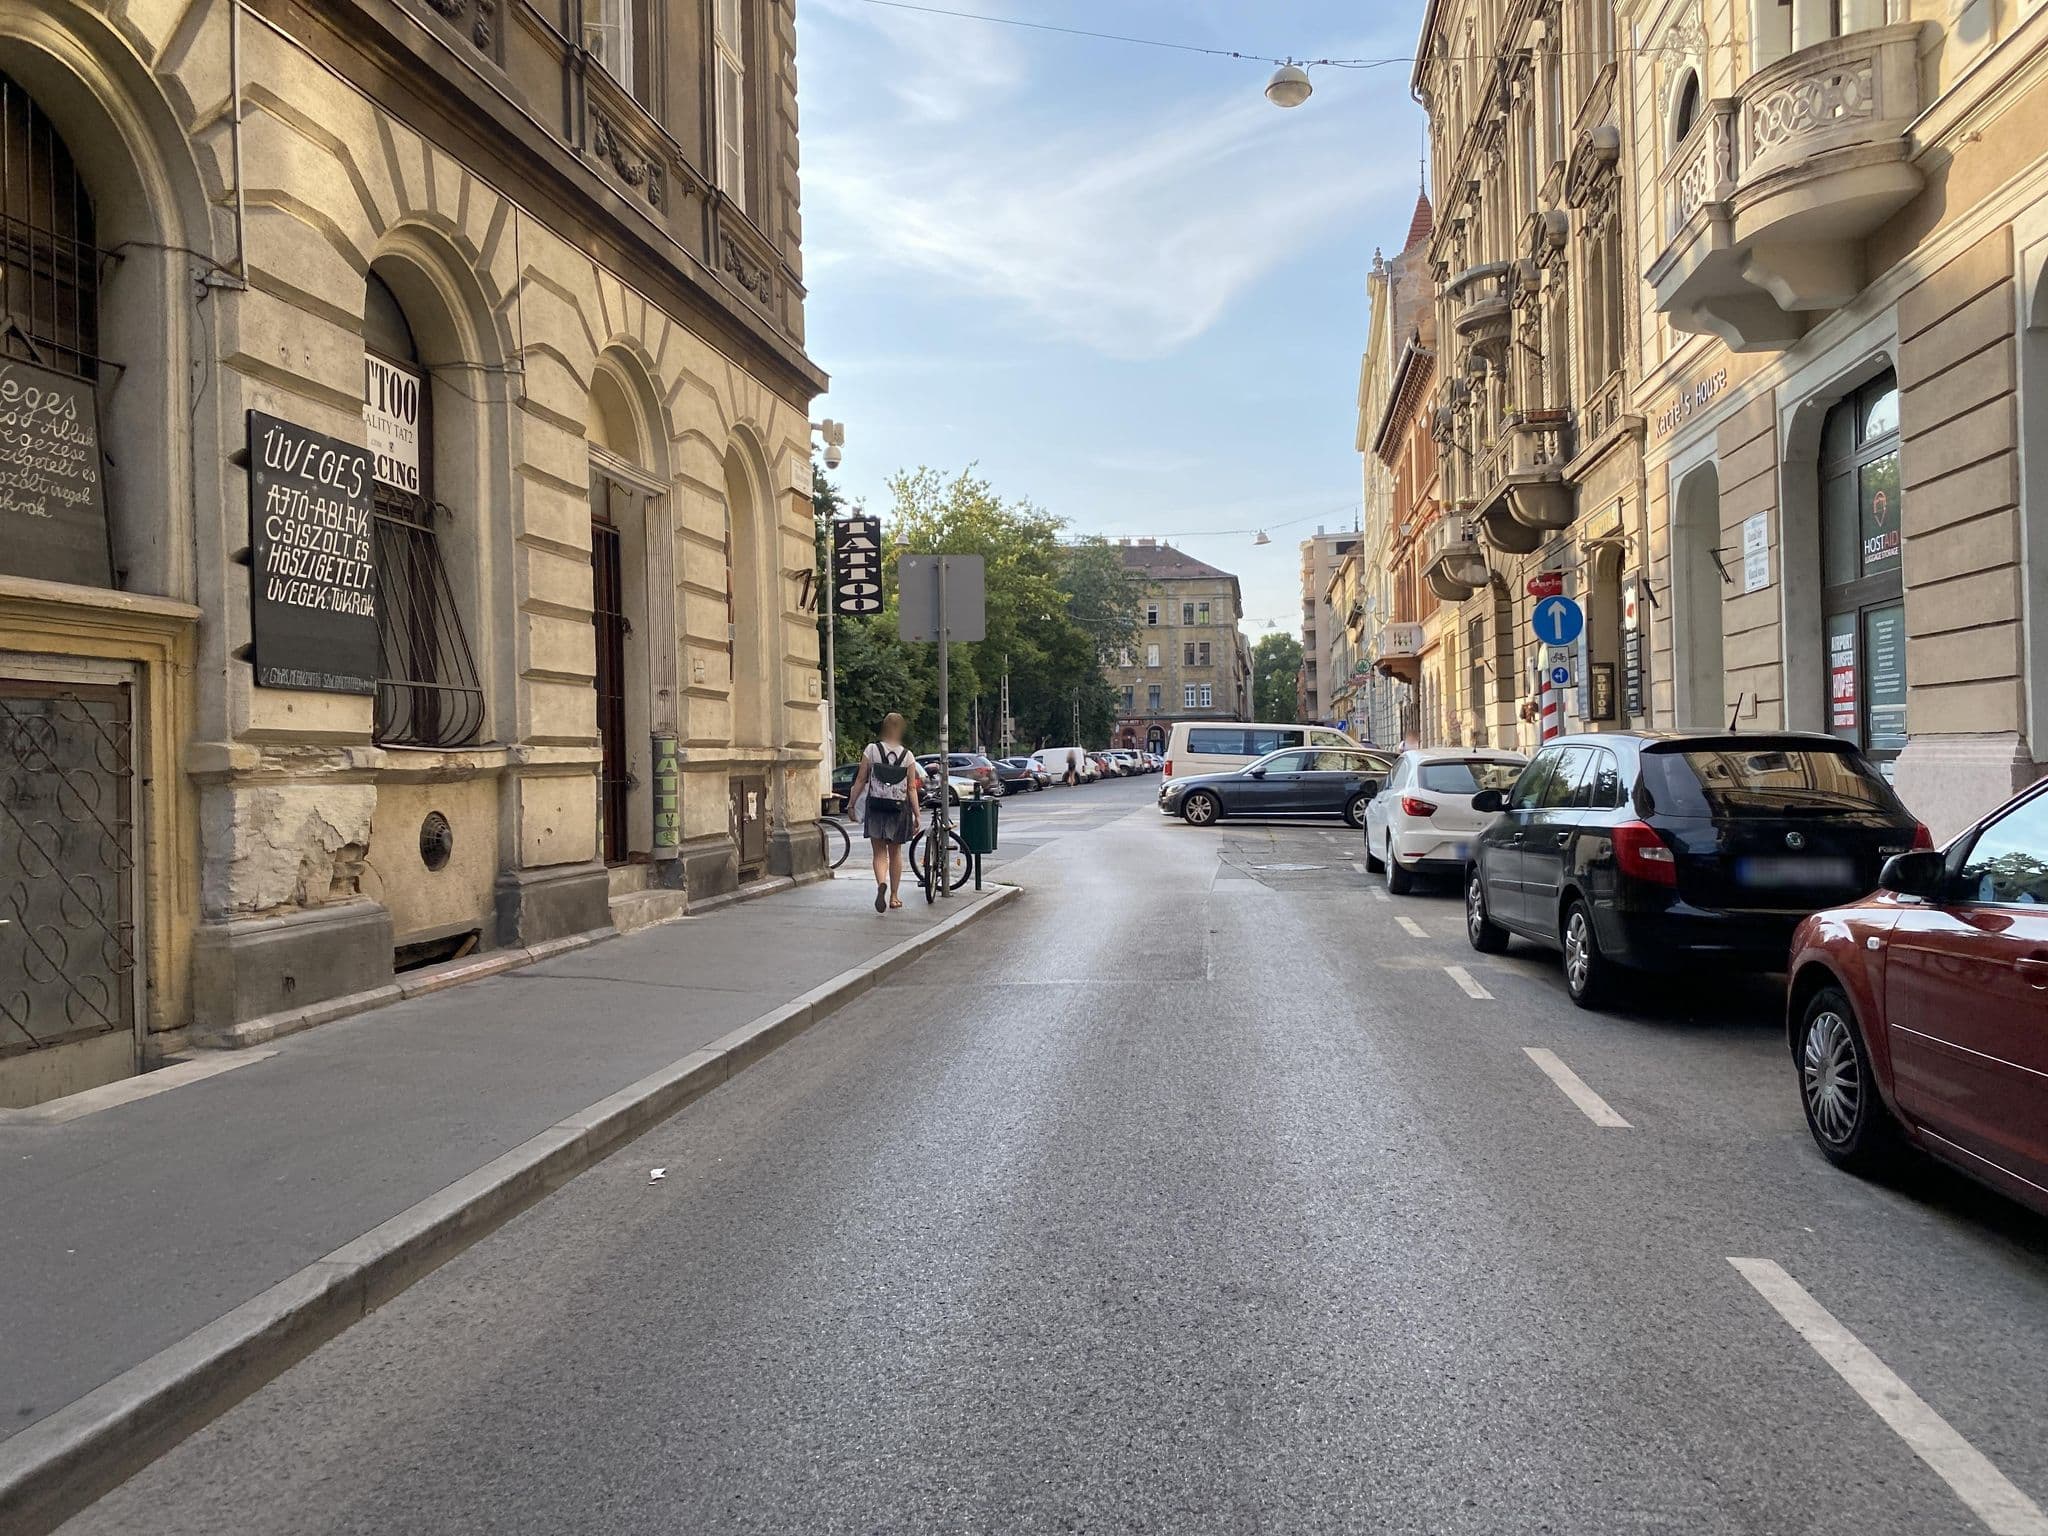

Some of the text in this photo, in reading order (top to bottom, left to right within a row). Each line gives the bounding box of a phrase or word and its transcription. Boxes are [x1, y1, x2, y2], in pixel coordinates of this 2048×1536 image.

[0, 365, 77, 428] eges
[365, 358, 417, 426] TTOO
[366, 413, 392, 434] ALITY
[264, 425, 366, 498] ÜVEGES
[373, 454, 417, 490] CING
[838, 521, 880, 611] TATTOO
[1864, 530, 1899, 555] HOSTAID
